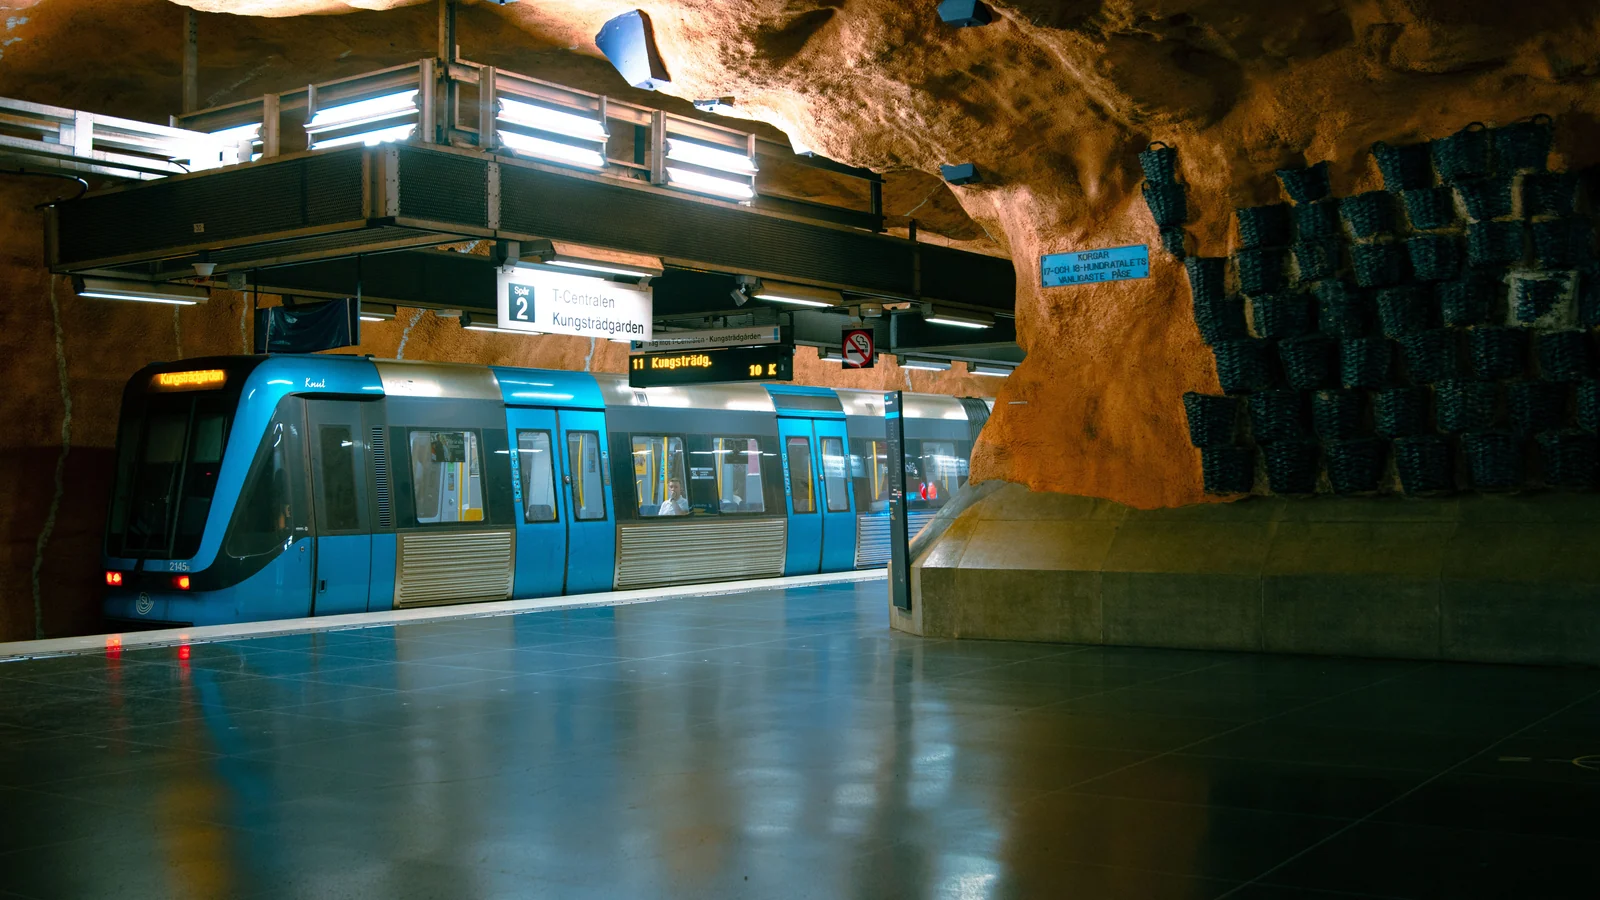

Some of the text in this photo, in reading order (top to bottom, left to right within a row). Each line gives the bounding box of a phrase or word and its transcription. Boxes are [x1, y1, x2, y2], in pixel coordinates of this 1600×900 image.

[1077, 251, 1109, 261] KORGAR
[1058, 269, 1132, 284] VANLIGASTE PÅSE
[514, 286, 530, 296] Spår
[552, 288, 615, 308] T-Centralen
[516, 297, 528, 320] 2
[552, 312, 644, 335] Kungsträdgården
[709, 333, 761, 343] Kungsträdgården
[633, 355, 713, 369] 11 Kungsträdg.
[749, 363, 777, 376] 10 K
